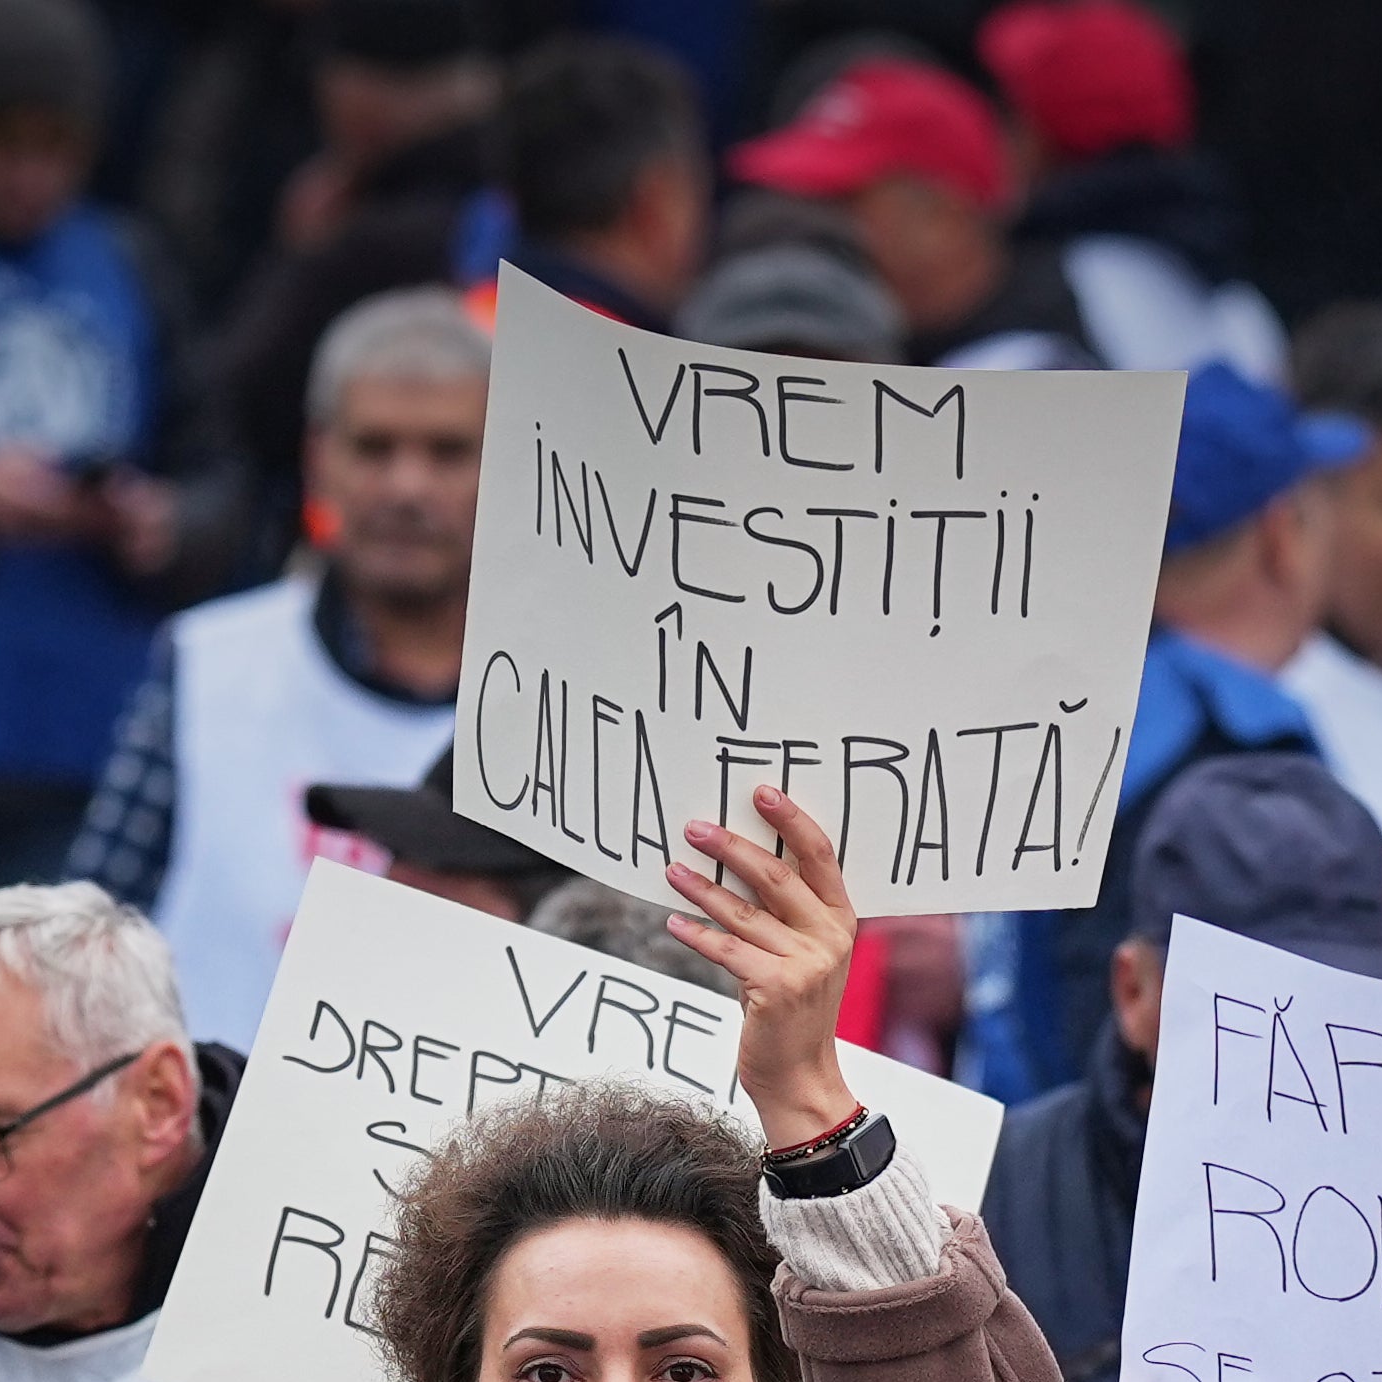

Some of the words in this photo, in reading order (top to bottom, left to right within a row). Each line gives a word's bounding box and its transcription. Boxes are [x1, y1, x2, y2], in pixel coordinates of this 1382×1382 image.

[618, 346, 966, 480] VREM
[654, 602, 753, 731] ÎN
[476, 649, 671, 868] CALEA
[505, 945, 740, 1106] VRE
